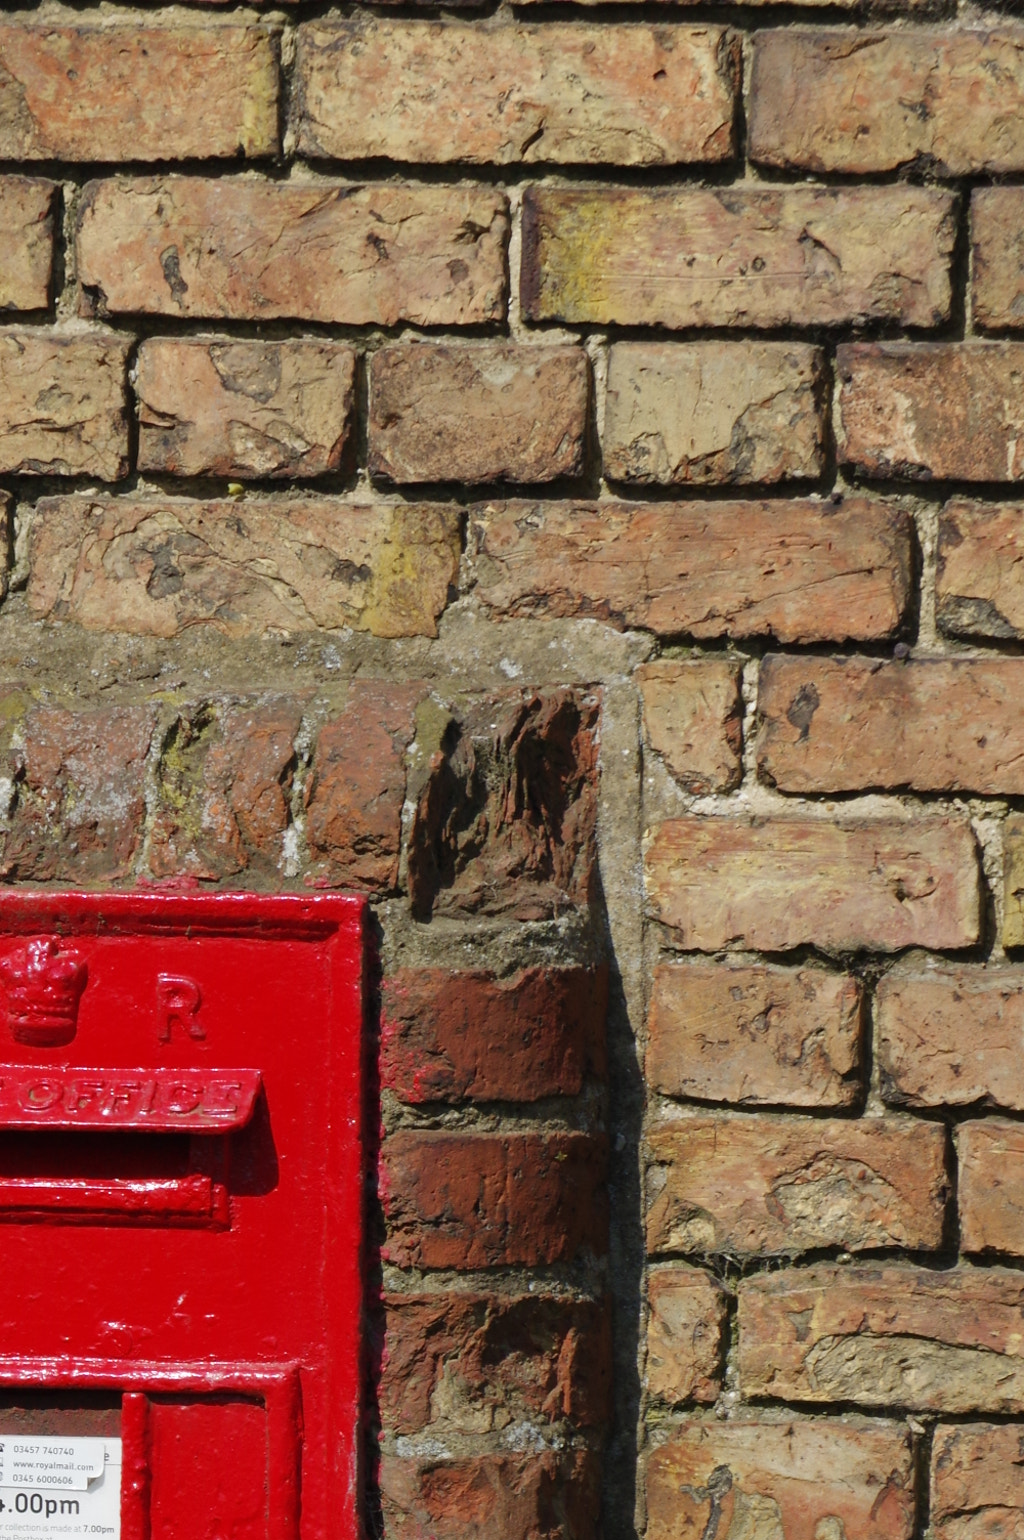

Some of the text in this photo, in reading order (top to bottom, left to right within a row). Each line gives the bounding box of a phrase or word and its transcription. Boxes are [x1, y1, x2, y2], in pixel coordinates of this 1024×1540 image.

[156, 972, 206, 1043] R
[19, 1078, 242, 1115] OFFICE
[13, 1445, 75, 1455] 03457 740740
[13, 1461, 94, 1472] www.royalmail.com
[12, 1474, 74, 1485] 0345 6000606
[5, 1523, 41, 1532] collection
[42, 1524, 49, 1532] is
[50, 1524, 72, 1533] made
[73, 1525, 82, 1533] at
[82, 1525, 115, 1535] 7.00pm
